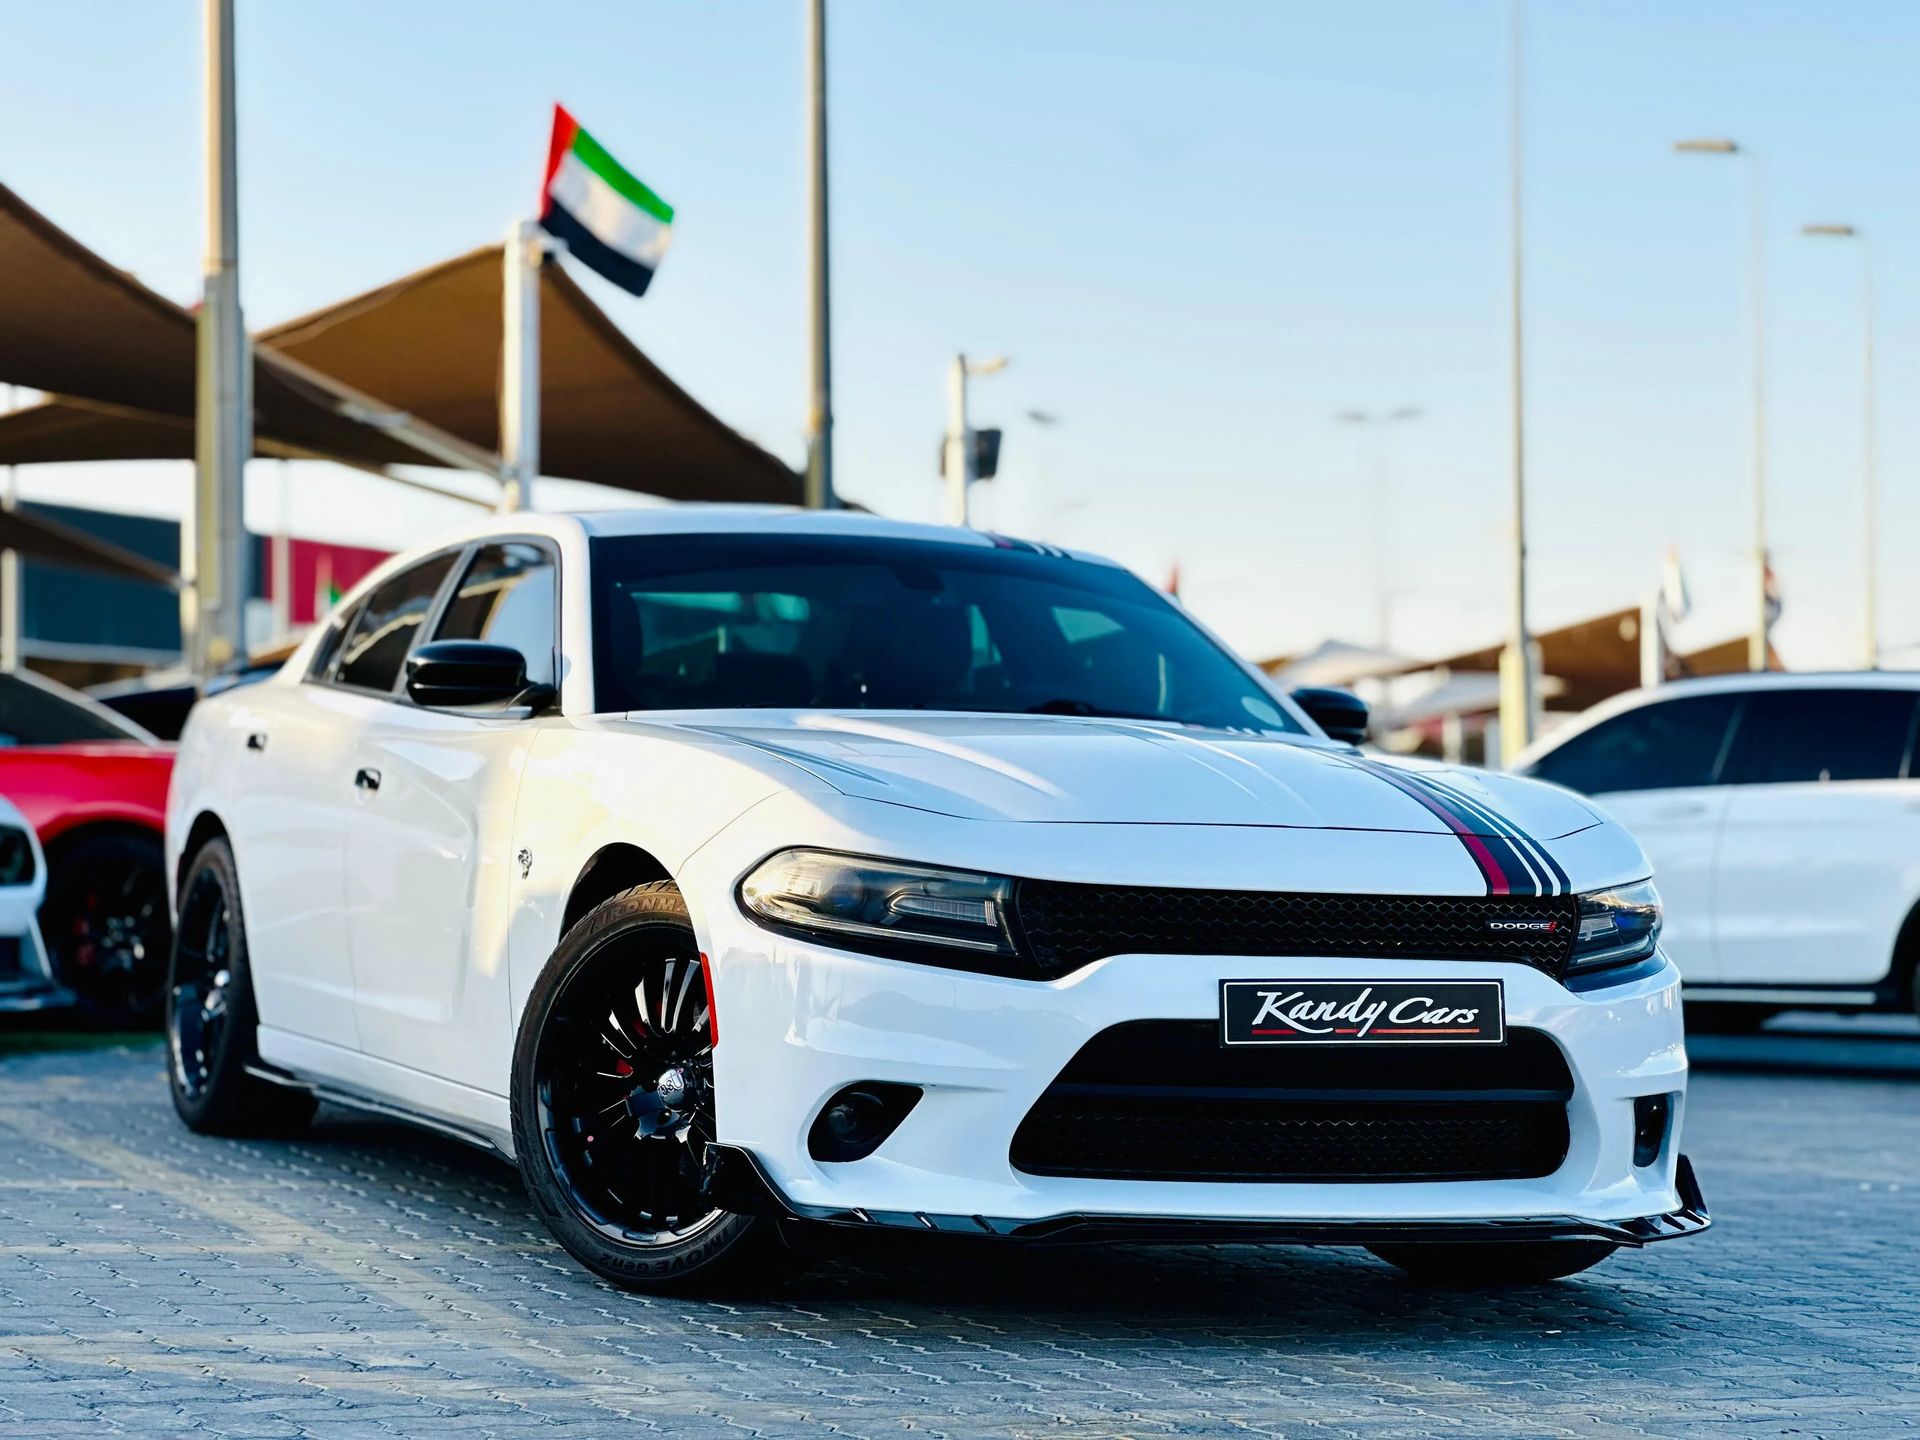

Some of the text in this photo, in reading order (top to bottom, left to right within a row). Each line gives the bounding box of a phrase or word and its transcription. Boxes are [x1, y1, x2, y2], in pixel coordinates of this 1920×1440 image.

[1490, 922, 1551, 930] DODGE
[1251, 987, 1480, 1038] Kandy Cars
